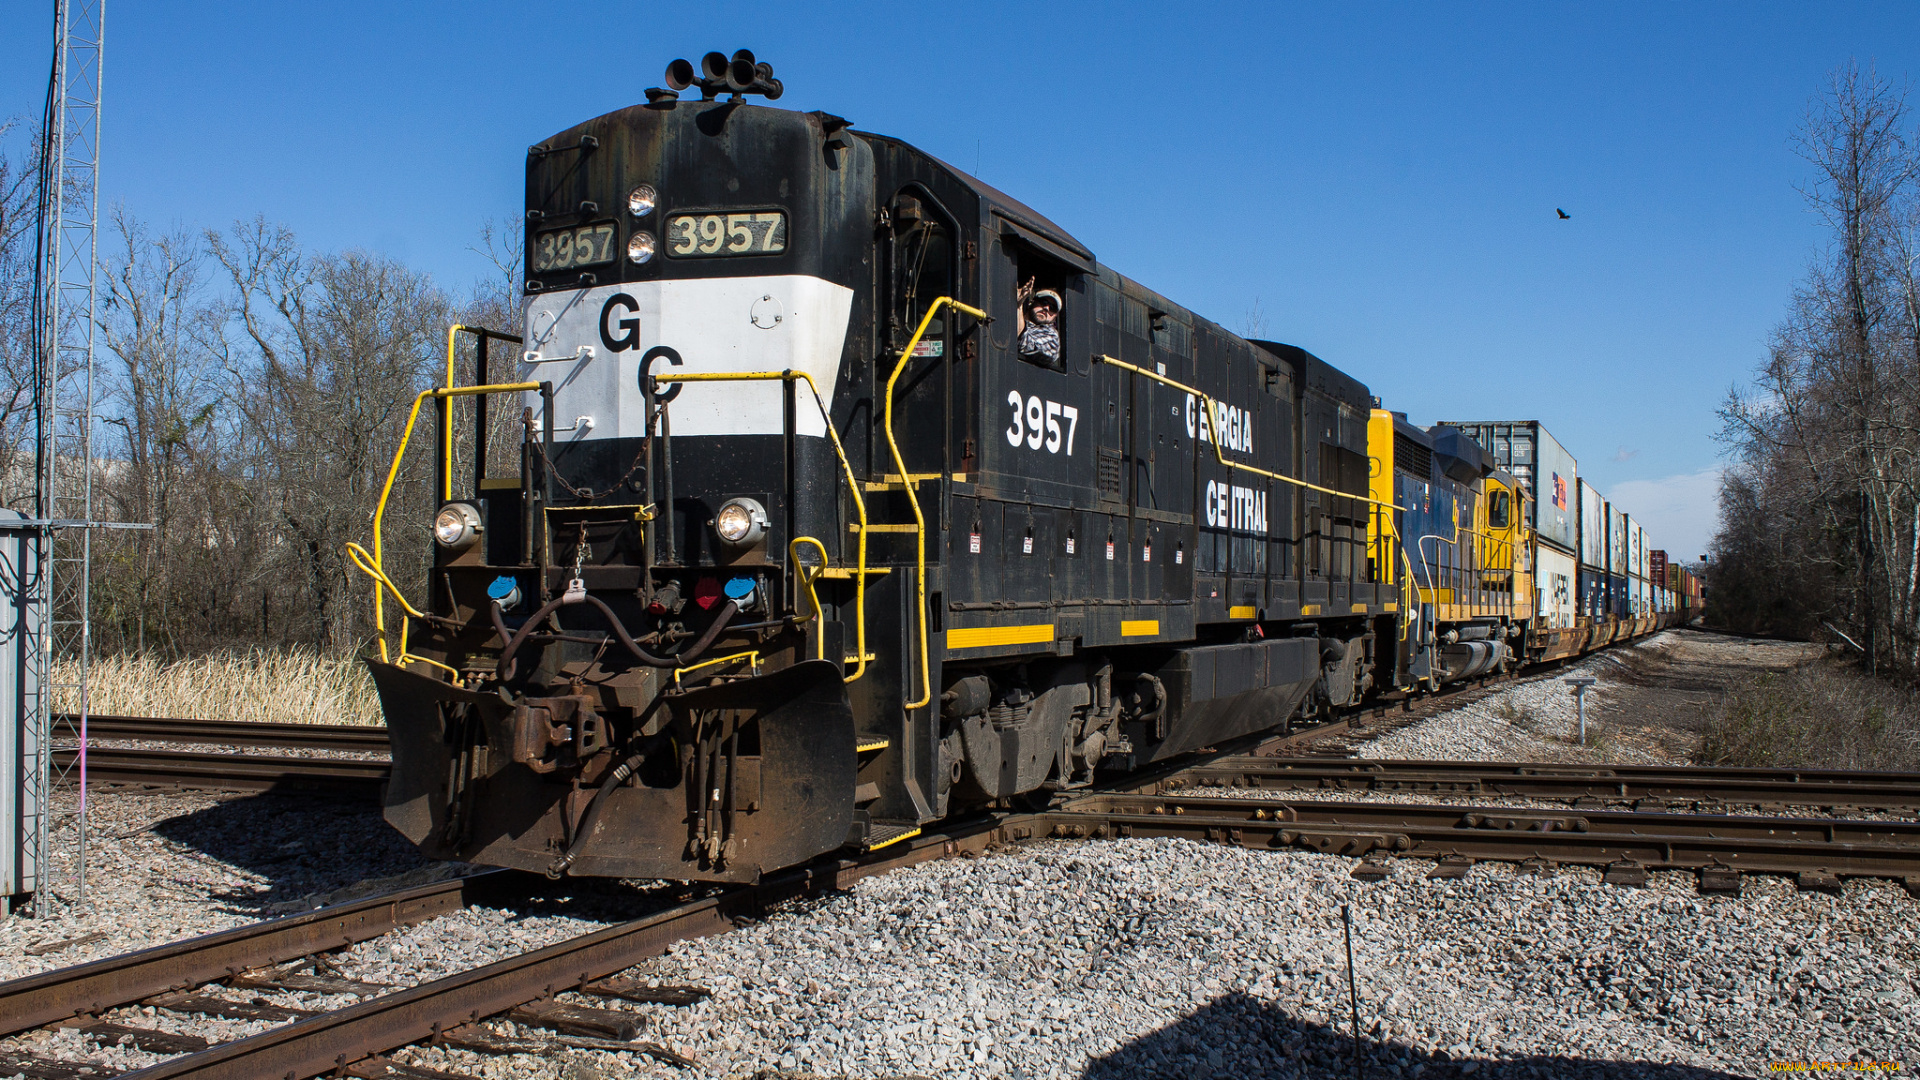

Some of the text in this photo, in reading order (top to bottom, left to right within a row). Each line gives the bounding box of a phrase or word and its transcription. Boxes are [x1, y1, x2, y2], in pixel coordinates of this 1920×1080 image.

[538, 226, 614, 270] 3957
[674, 212, 781, 255] 3957
[599, 293, 641, 353] G
[638, 345, 683, 404] C
[1006, 390, 1079, 456] 3957
